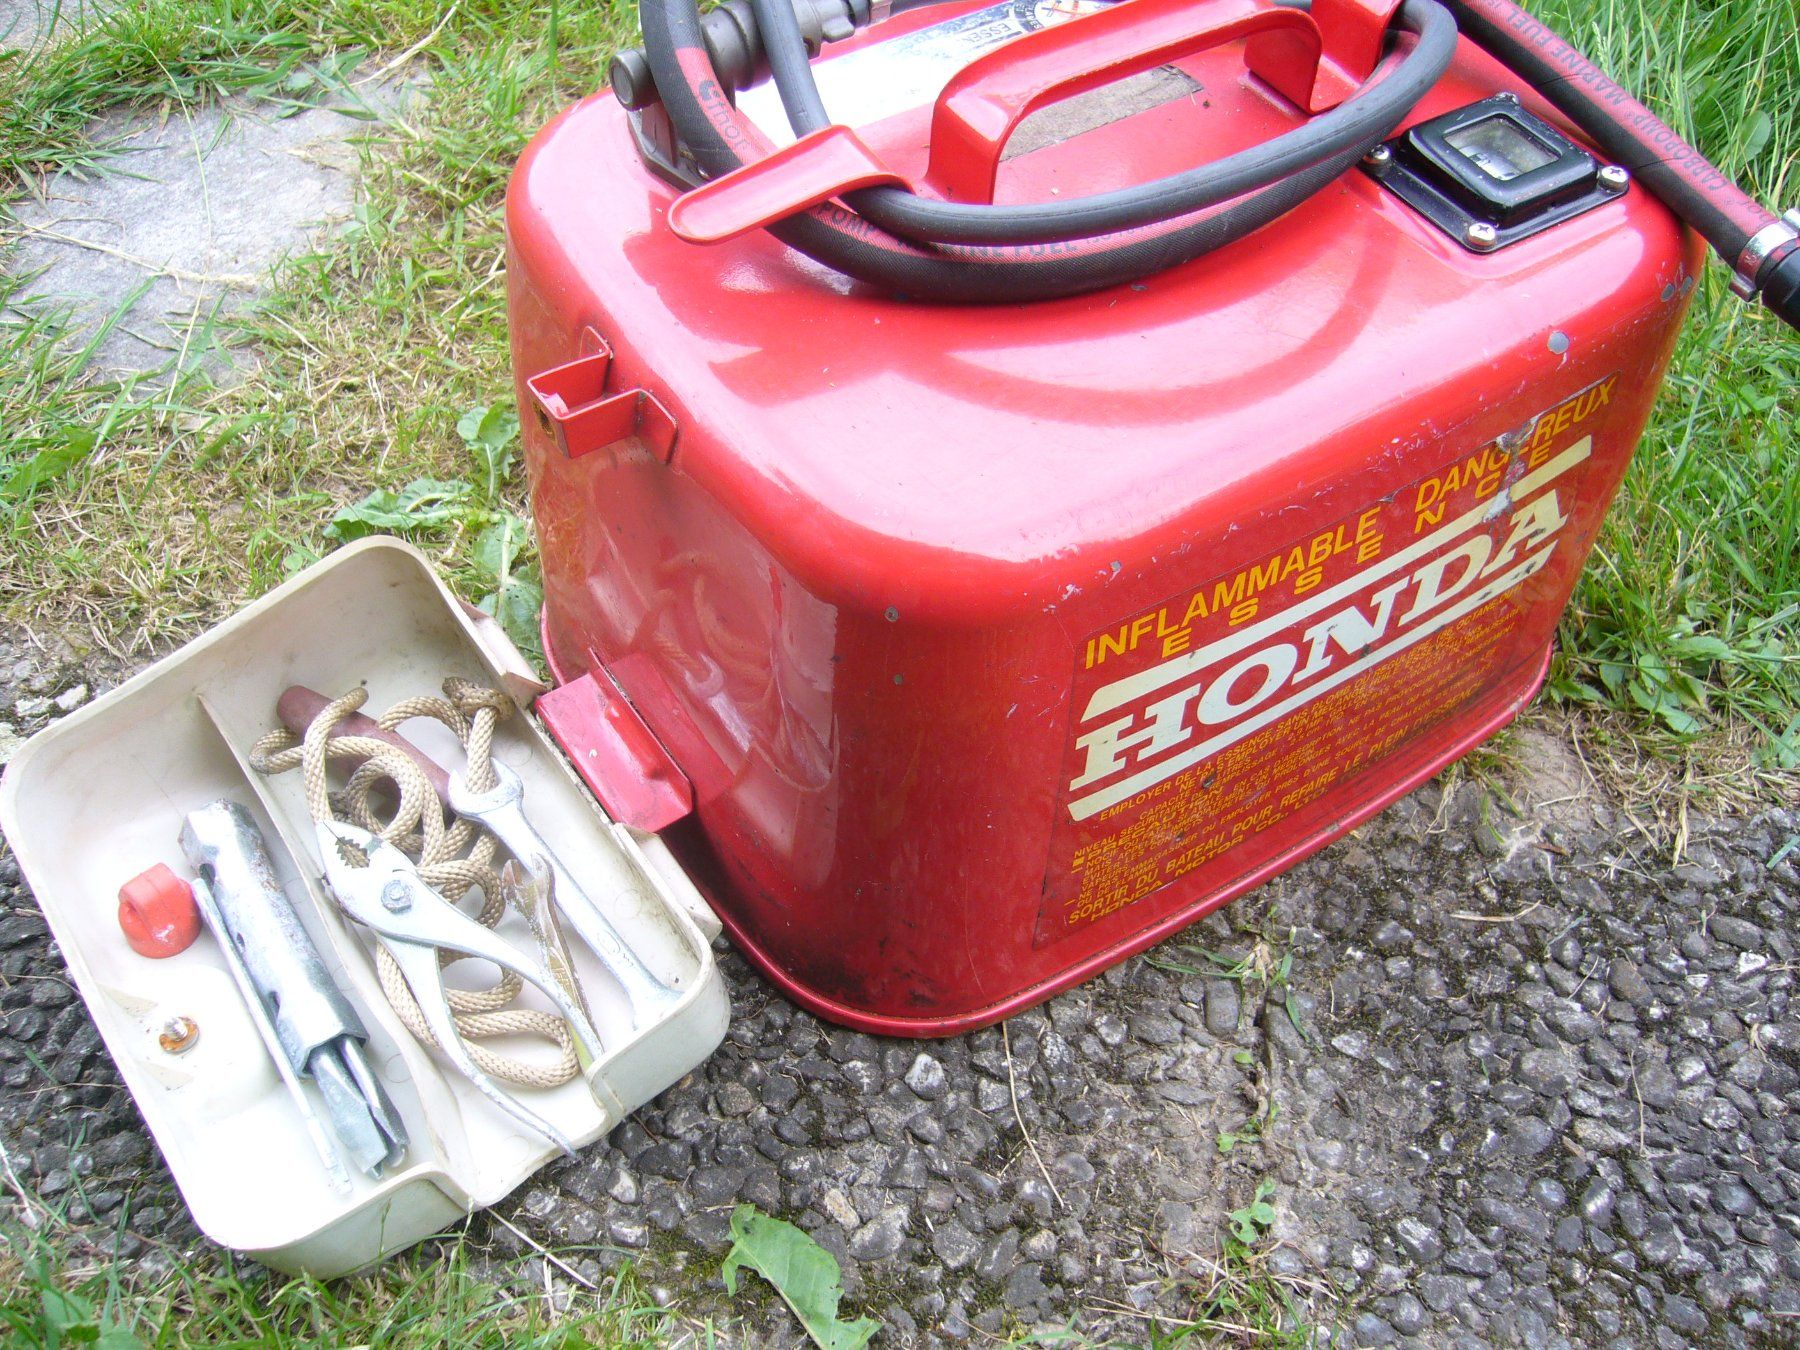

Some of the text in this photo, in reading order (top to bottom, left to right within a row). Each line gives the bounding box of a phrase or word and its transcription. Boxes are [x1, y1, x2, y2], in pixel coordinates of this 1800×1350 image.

[1506, 12, 1554, 48] FUEL
[1550, 40, 1628, 106] MARINE
[1084, 374, 1618, 671] INFLAMMABLE DANGREUX
[1068, 489, 1569, 794] HONDA
[1099, 779, 1171, 822] EMPLOYER
[1174, 769, 1192, 787] DE
[1195, 760, 1212, 776] LA
[1215, 726, 1273, 765] ESSENCE
[1275, 707, 1309, 732] SANS
[1310, 683, 1351, 714] PLOMB
[1353, 672, 1371, 689] OU
[1454, 596, 1499, 632] OCTANE
[1178, 776, 1196, 793] NE
[1199, 762, 1224, 783] PAS
[1226, 724, 1292, 768] EMPLOYER
[1292, 714, 1310, 731] UN
[1311, 682, 1367, 721] MELANGE
[1216, 754, 1252, 780] LITRES
[1328, 686, 1375, 719] GALLONS
[1068, 883, 1129, 925] SORTIR
[1135, 867, 1158, 890] DU
[1164, 829, 1225, 874] BATEAU
[1230, 802, 1274, 837] POUR
[1278, 764, 1339, 810] REFAIRE
[1342, 750, 1363, 774] LE
[1366, 722, 1410, 759] PLEIN
[1073, 832, 1116, 860] NIVEAU
[1119, 797, 1187, 838] SECURITAIRE
[1190, 788, 1204, 802] DE
[1208, 747, 1277, 792] REMPLISSAGE
[1078, 887, 1093, 901] NE
[1097, 874, 1119, 891] PAS
[1123, 831, 1198, 877] EMMAGASINER
[1201, 821, 1216, 835] OU
[1219, 789, 1272, 825] EMPLOYER
[1302, 755, 1331, 778] D'UNE
[1333, 732, 1371, 761] SOURCE
[1081, 860, 1120, 886] EVITER
[1124, 846, 1145, 864] LES
[1255, 776, 1271, 792] OU
[1272, 742, 1332, 782] PROLONGES
[1083, 857, 1112, 878] MAIS
[1253, 771, 1269, 785] UN
[1085, 846, 1119, 869] NOCIF
[1122, 836, 1139, 851] OU
[1141, 818, 1173, 841] FATAL
[1232, 777, 1247, 792] EN
[1249, 763, 1271, 782] CAS
[1087, 785, 1223, 861] PRECAUTION
[1076, 894, 1092, 908] OU
[1096, 885, 1110, 898] DE
[1090, 877, 1164, 922] HONDA
[1174, 832, 1244, 878] MOTOR
